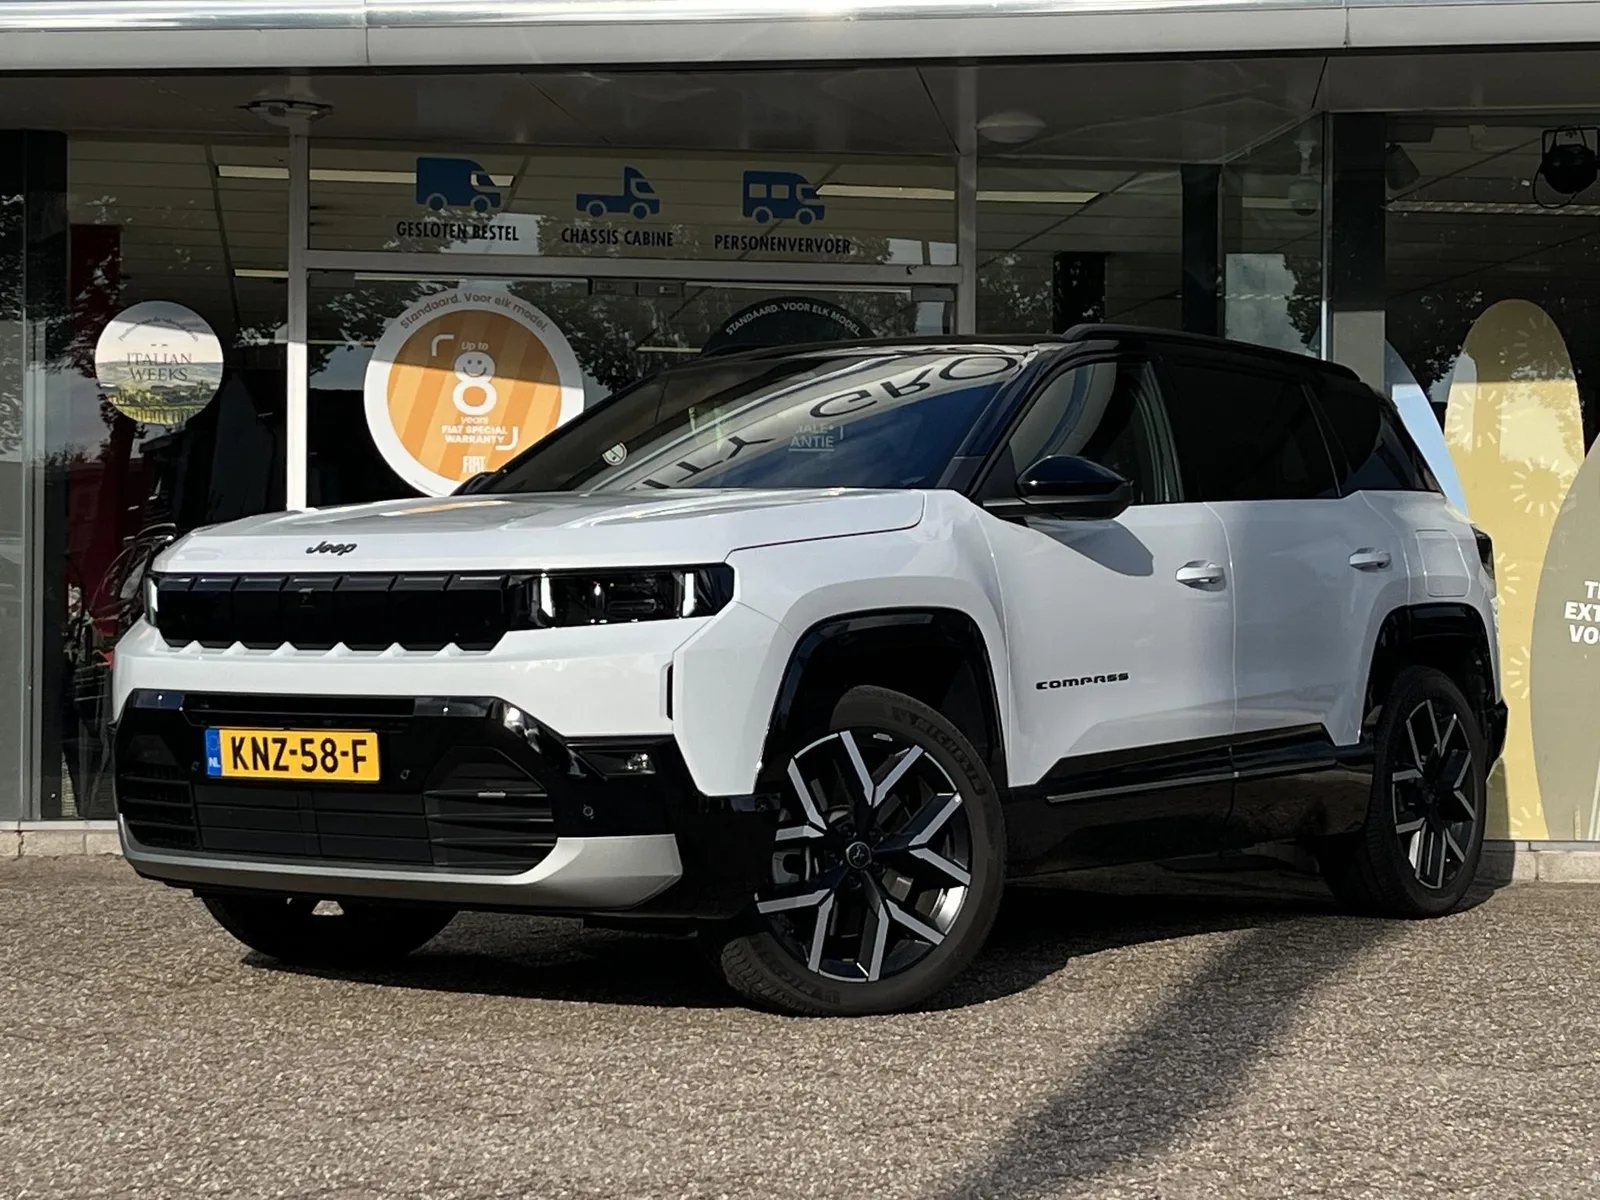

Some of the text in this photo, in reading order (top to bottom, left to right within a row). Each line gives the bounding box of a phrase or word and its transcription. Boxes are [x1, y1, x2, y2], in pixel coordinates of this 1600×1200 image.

[396, 221, 519, 240] GESLOTEN BESTEL
[561, 227, 673, 246] CHASSIS CABINE
[714, 234, 850, 254] PERSONENVERVOER
[464, 292, 492, 303] Voor
[494, 297, 511, 308] elk
[782, 302, 811, 312] VOOR
[812, 305, 829, 317] ELK
[461, 341, 489, 351] Up to
[126, 352, 193, 365] ITALIAN
[128, 367, 188, 381] WEEKS
[442, 425, 508, 434] FIAT SPECIAL
[445, 434, 505, 444] WARRANTY
[463, 456, 486, 473] FIAT
[305, 540, 357, 556] Jeep
[1569, 624, 1600, 645] VO
[1035, 673, 1129, 690] COMPASS
[208, 757, 220, 768] NL
[231, 736, 368, 773] KNZ-58-F
